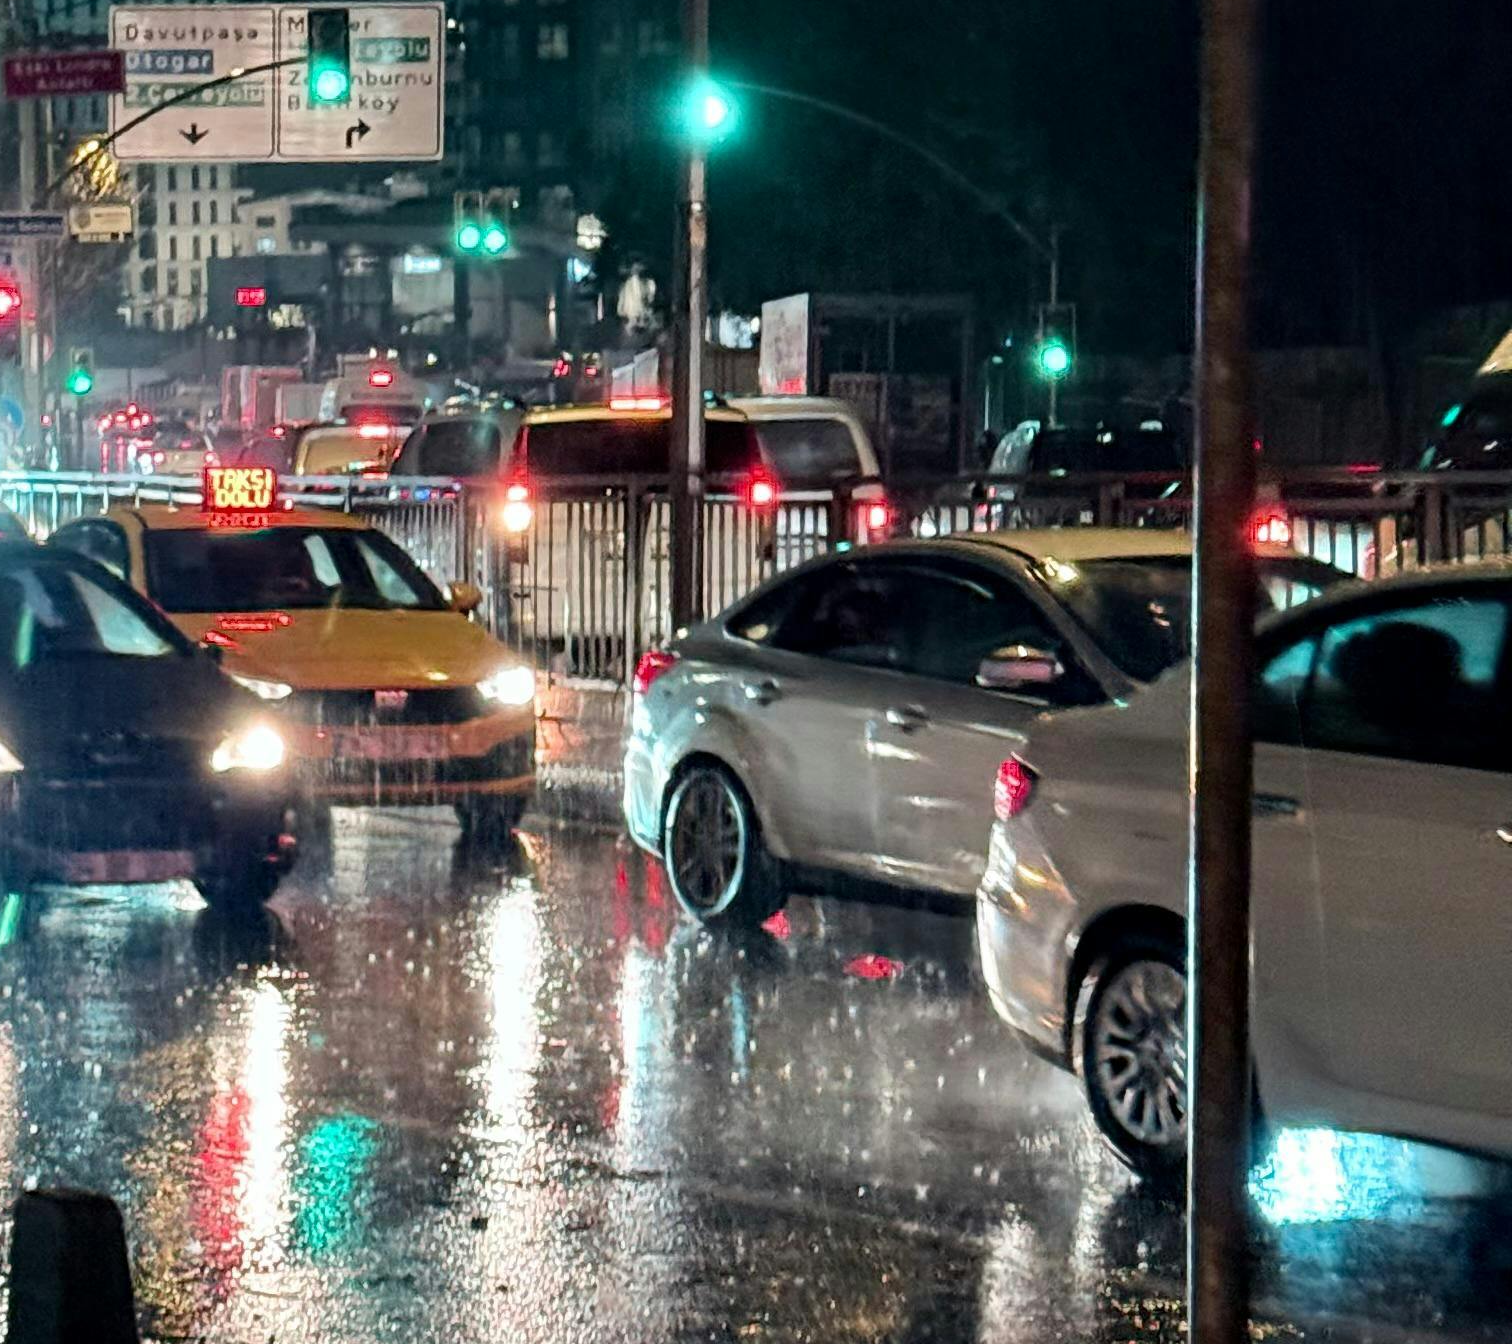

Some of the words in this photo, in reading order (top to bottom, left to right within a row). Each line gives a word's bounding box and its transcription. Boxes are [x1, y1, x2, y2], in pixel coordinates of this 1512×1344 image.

[124, 22, 260, 45] Davutpaşa
[288, 16, 373, 34] Mer
[125, 50, 212, 72] Otogar
[288, 69, 433, 87] Znburnu
